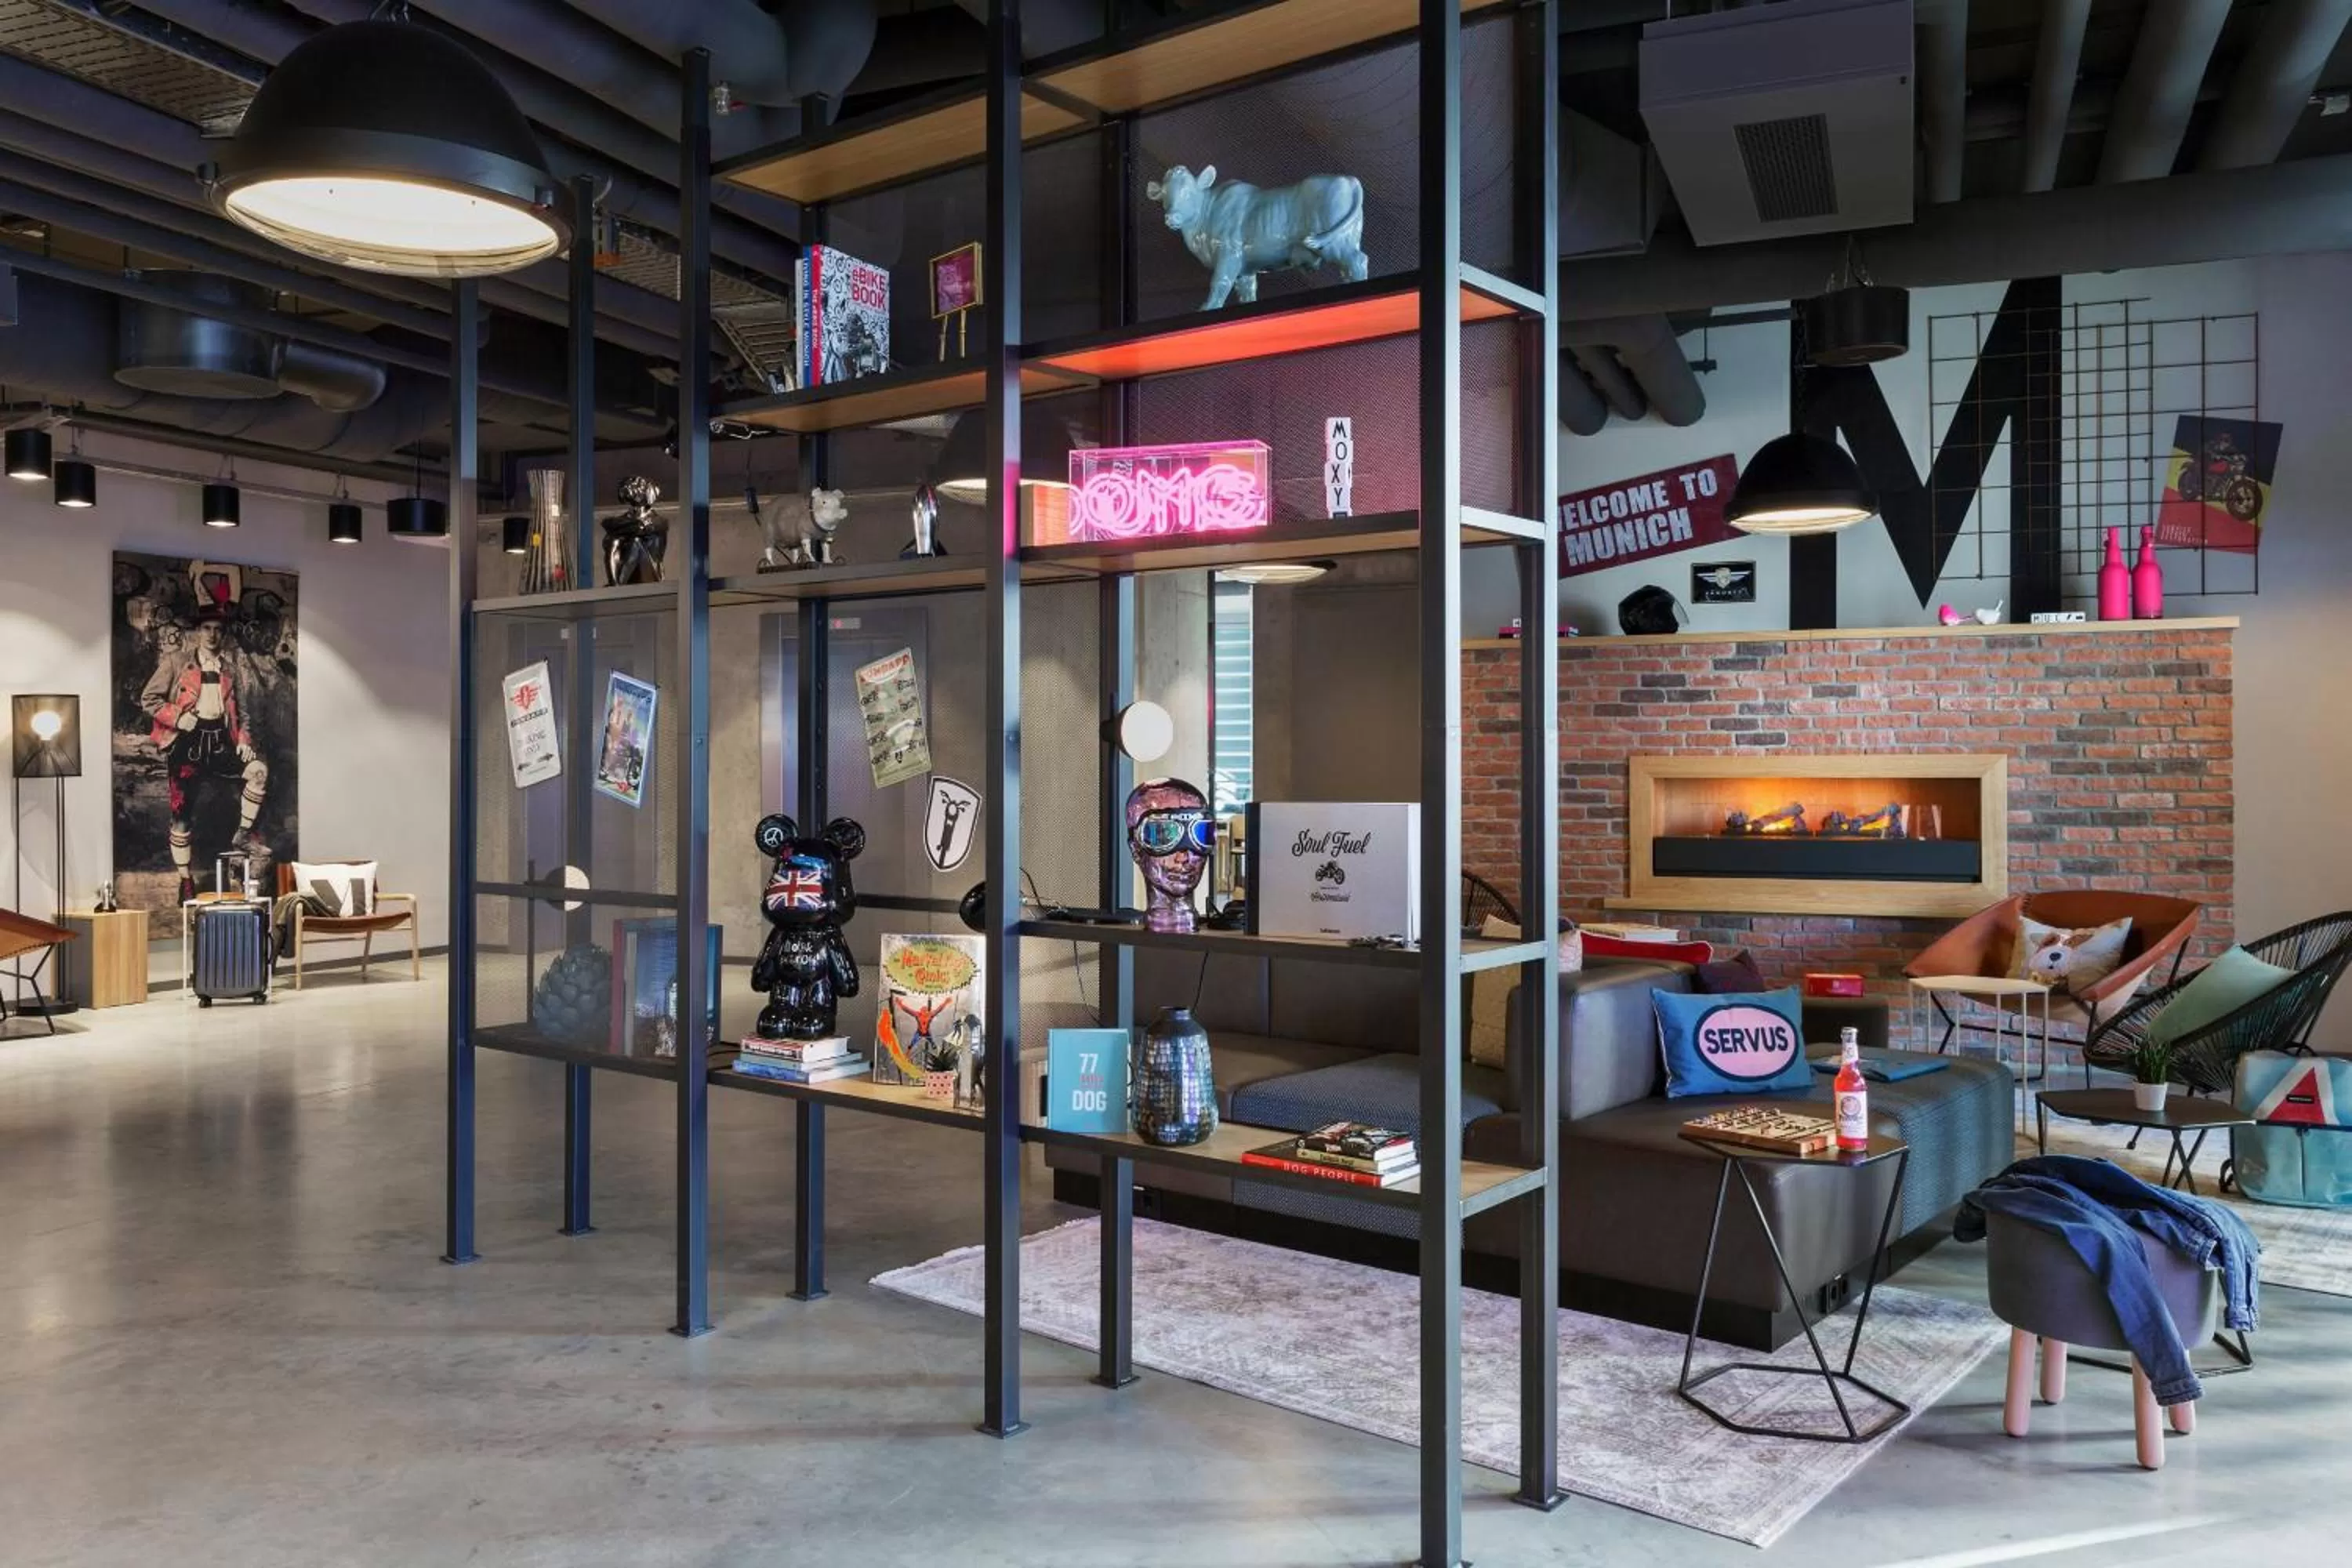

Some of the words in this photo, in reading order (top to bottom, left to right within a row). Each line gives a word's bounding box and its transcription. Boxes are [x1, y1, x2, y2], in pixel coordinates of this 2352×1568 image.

[852, 266, 887, 292] eBIKE
[852, 282, 887, 311] BOOK
[1330, 420, 1348, 506] MOXY
[1679, 468, 1719, 501] TO
[1565, 507, 1694, 567] MUNICH
[1292, 829, 1330, 857] Soul
[1330, 832, 1372, 858] Fuel
[1704, 1026, 1788, 1054] SERVUS
[1079, 1054, 1098, 1073] 77
[1073, 1091, 1107, 1111] DOG
[1313, 1167, 1356, 1183] PEOPLE
